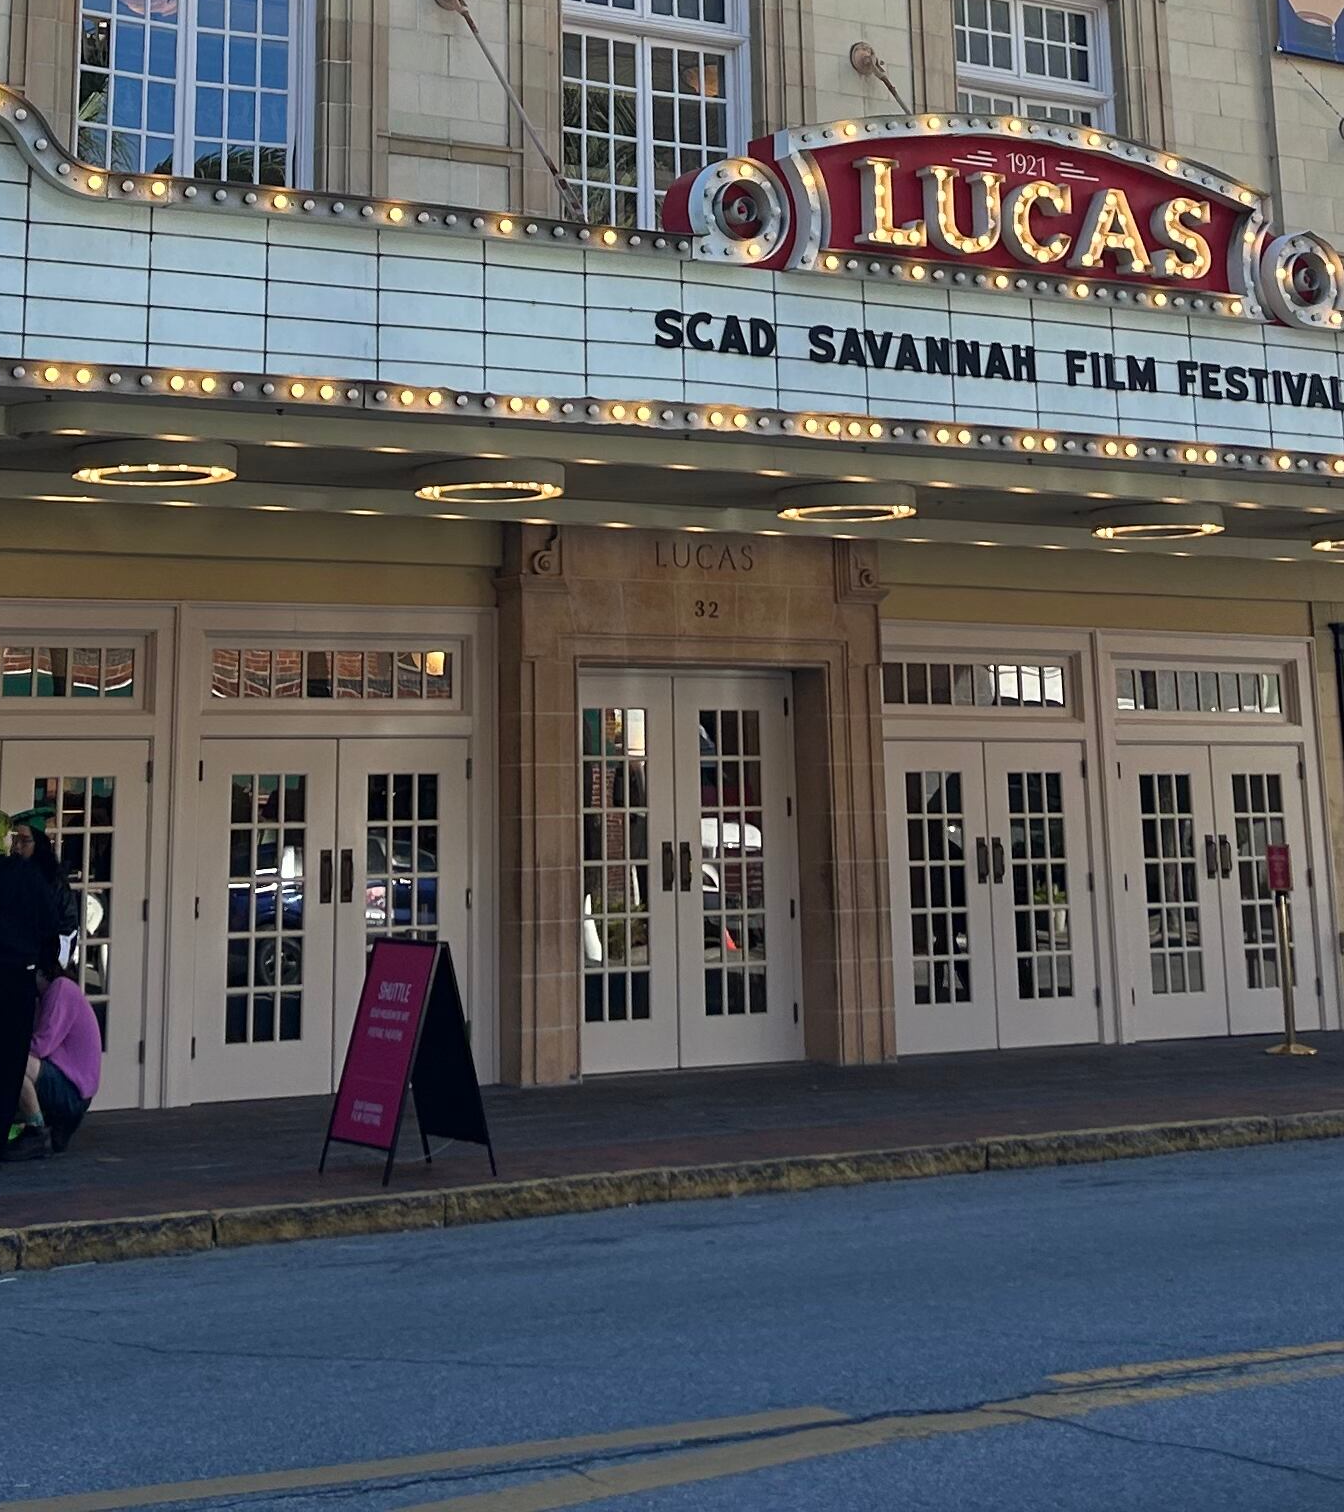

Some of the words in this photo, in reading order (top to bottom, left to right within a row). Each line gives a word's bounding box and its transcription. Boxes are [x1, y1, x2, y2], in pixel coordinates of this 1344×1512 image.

[1006, 152, 1048, 177] 1921
[853, 156, 1212, 279] LUCAS
[654, 309, 776, 357] SCAD
[808, 325, 1037, 383] SAVANNAH
[1066, 349, 1157, 393] FILM
[655, 541, 754, 571] LUCAS
[694, 600, 719, 618] 32
[378, 981, 412, 1003] SHUTTLE
